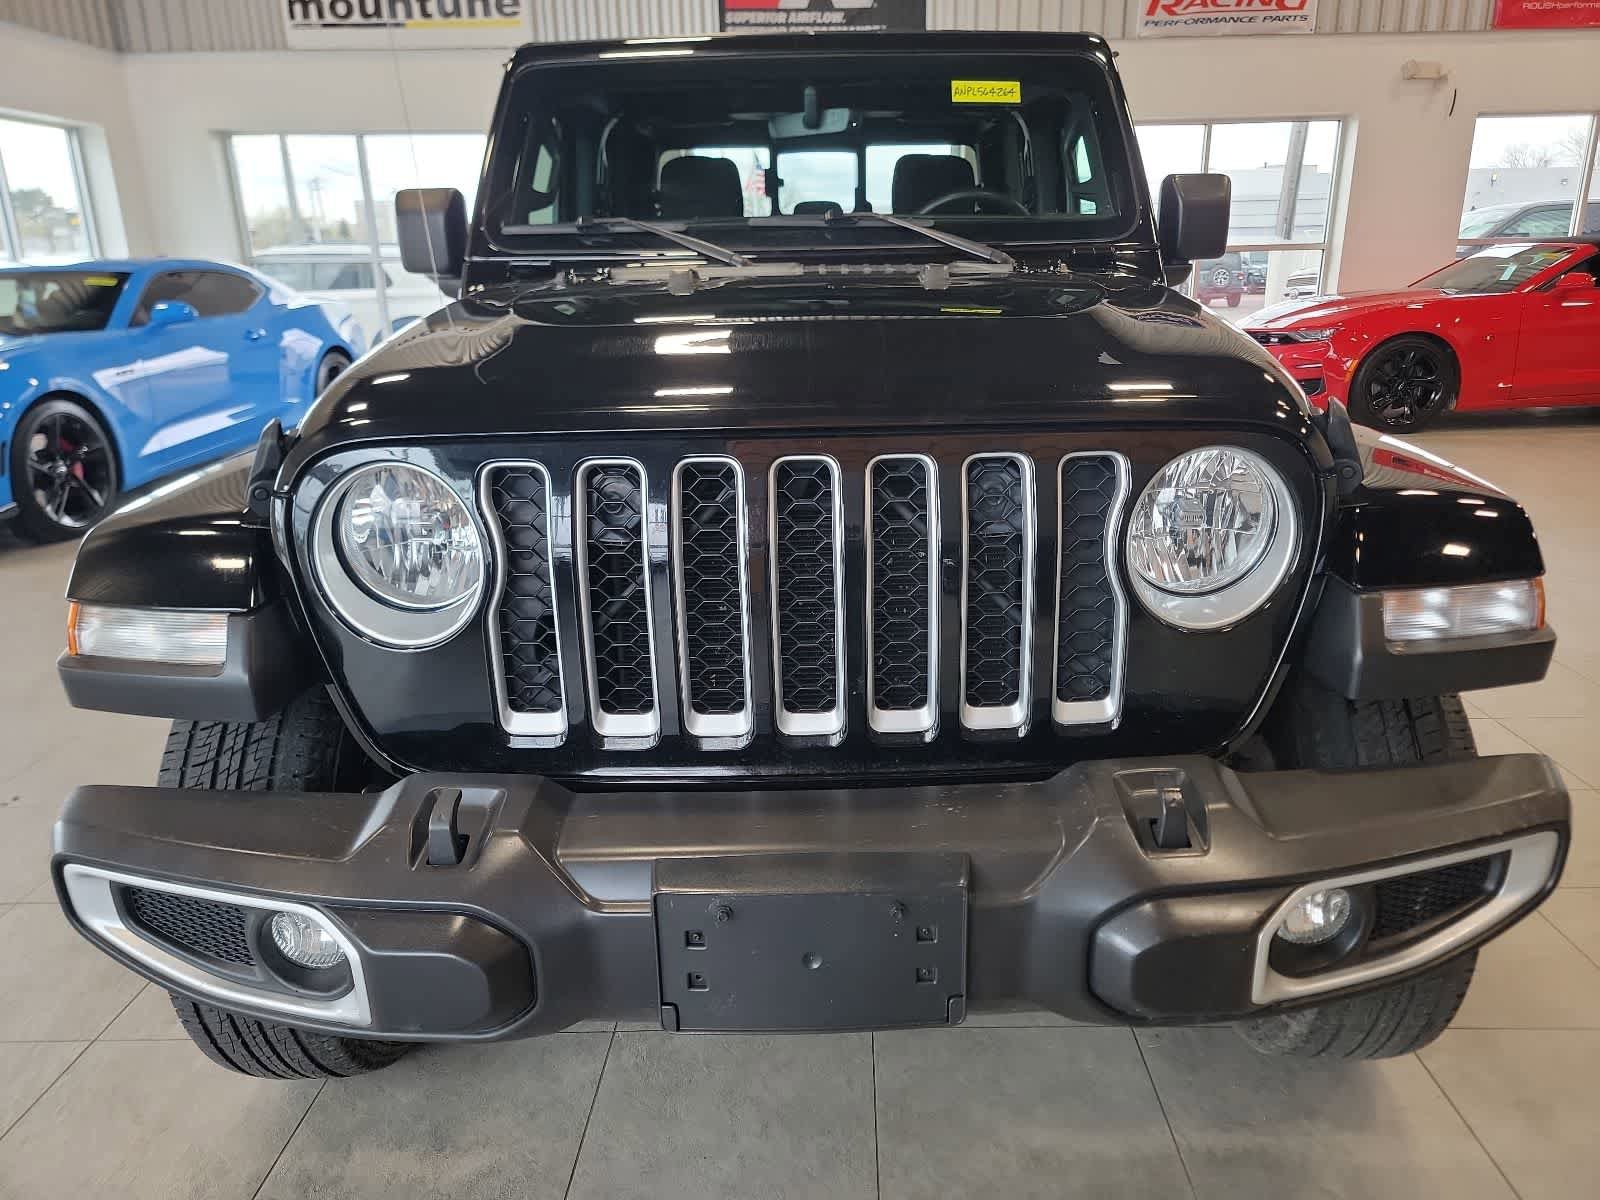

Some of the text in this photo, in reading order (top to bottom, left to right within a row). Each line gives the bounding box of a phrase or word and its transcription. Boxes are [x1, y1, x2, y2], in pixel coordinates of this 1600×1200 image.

[288, 0, 522, 19] mountune
[1144, 14, 1309, 26] PERFORMANCE PARTS
